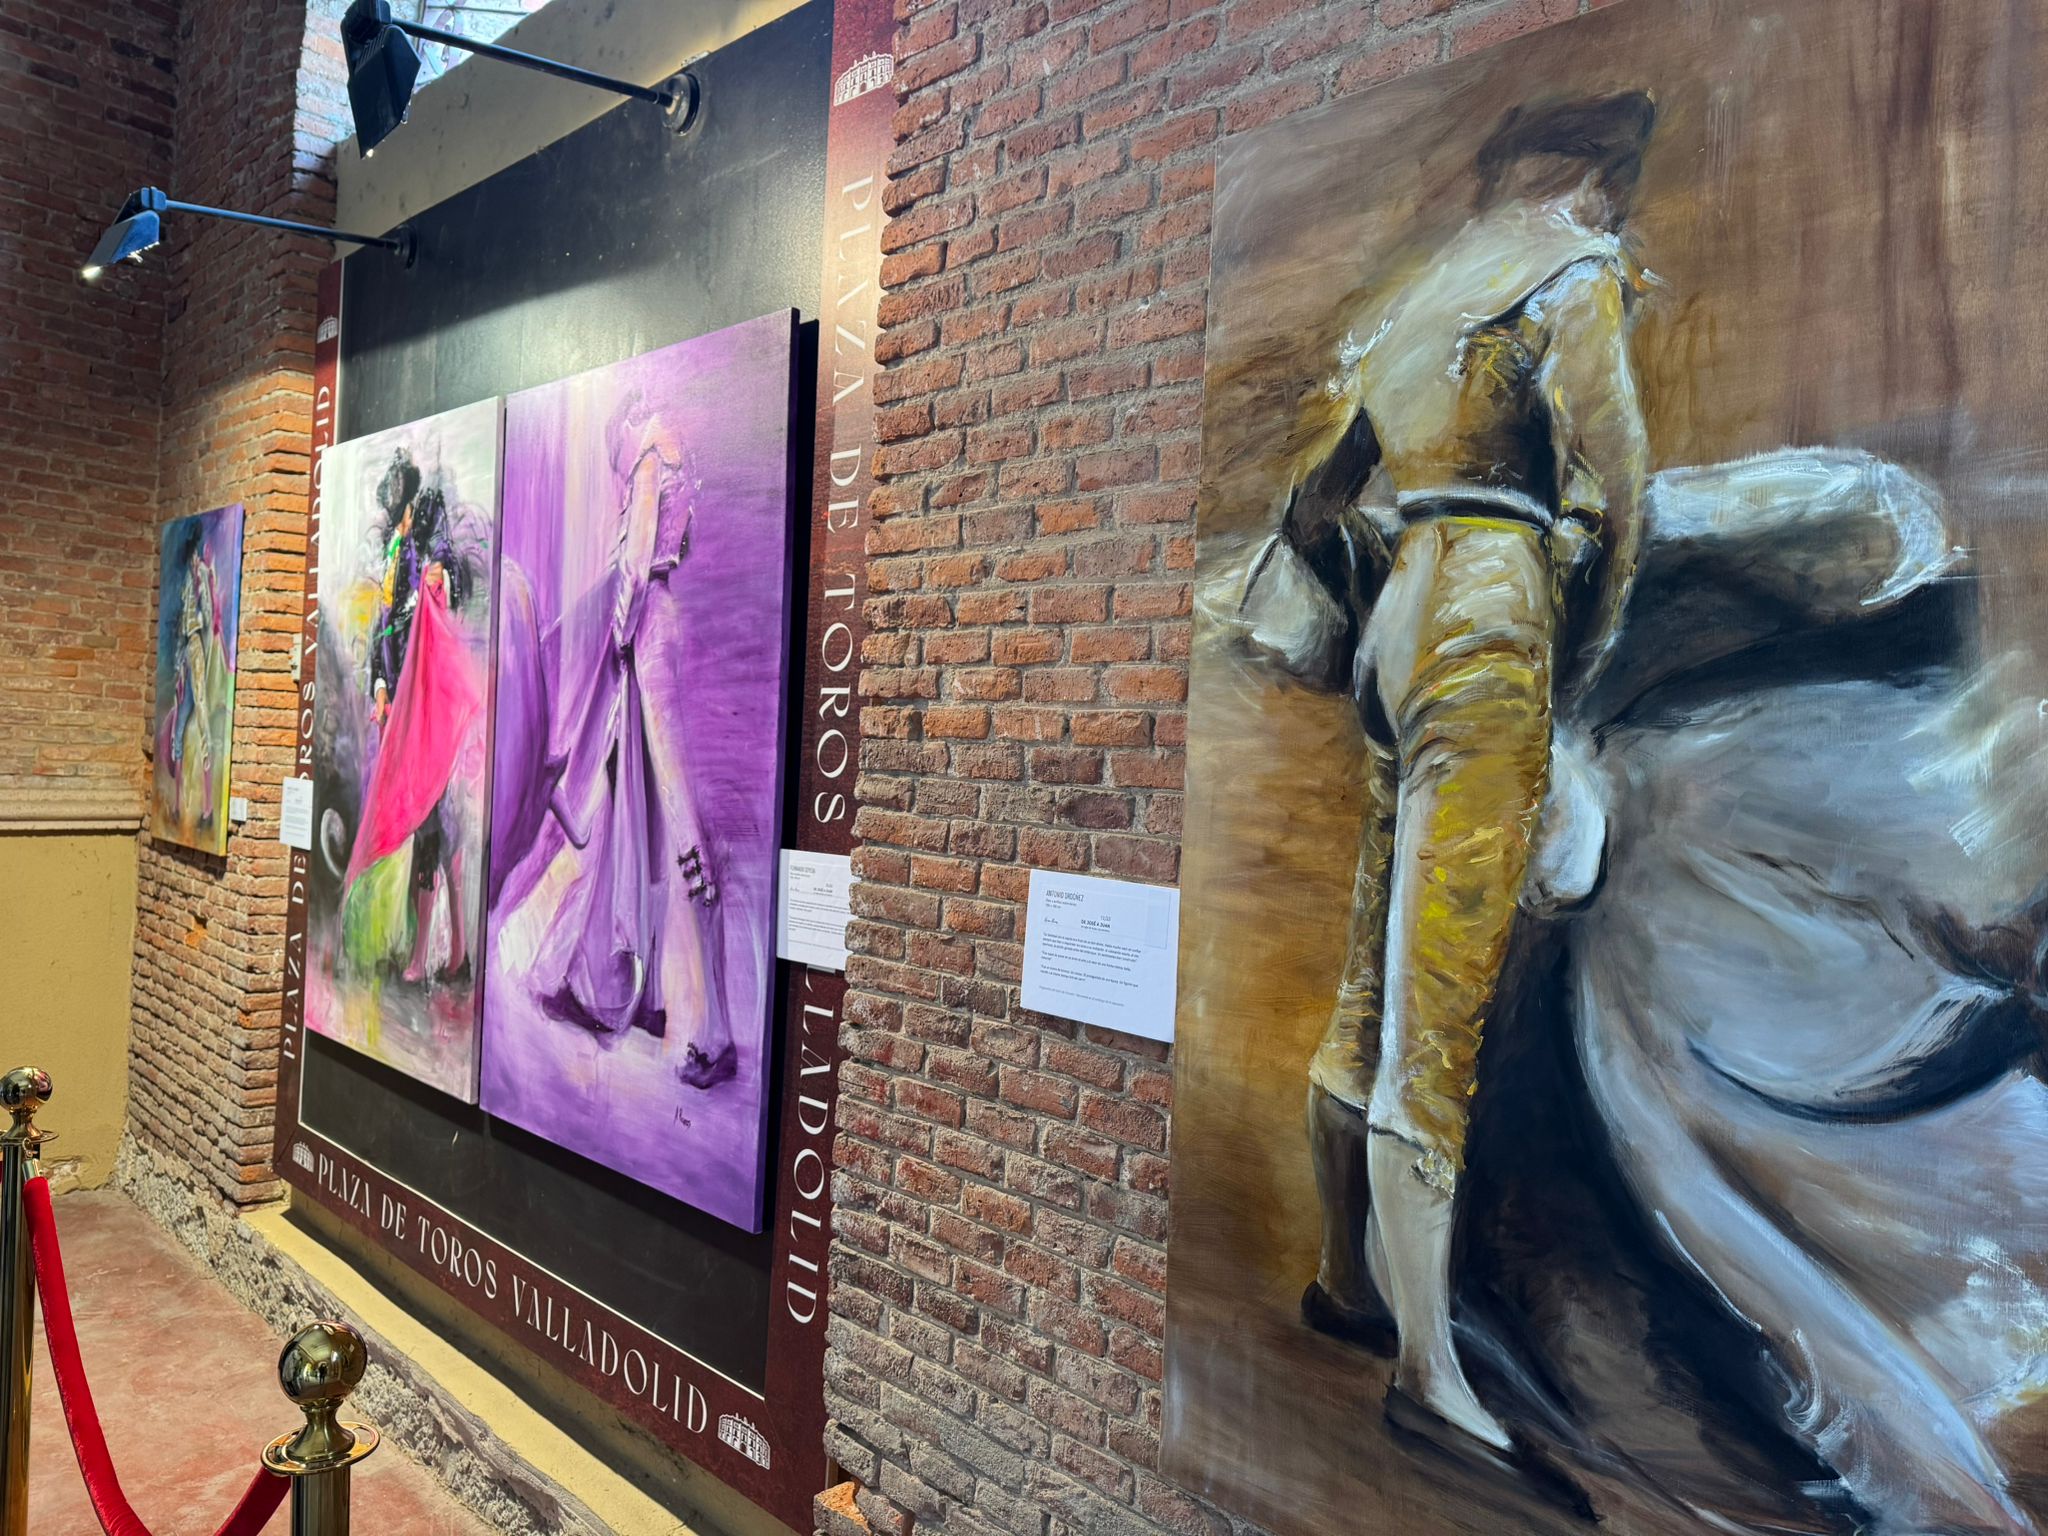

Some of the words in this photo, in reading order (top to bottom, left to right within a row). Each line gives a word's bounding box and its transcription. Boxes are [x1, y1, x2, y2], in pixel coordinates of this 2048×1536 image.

[832, 174, 874, 405] PLAZA
[827, 443, 862, 535] DE
[813, 573, 857, 825] TOROS
[291, 854, 307, 905] DE
[282, 932, 303, 1060] PLAZA
[786, 963, 837, 1324] LLADOLID
[317, 1152, 371, 1219] PLAZA
[381, 1193, 407, 1240] DE
[418, 1215, 498, 1300] TOROS
[512, 1274, 708, 1434] VALLADOLID
